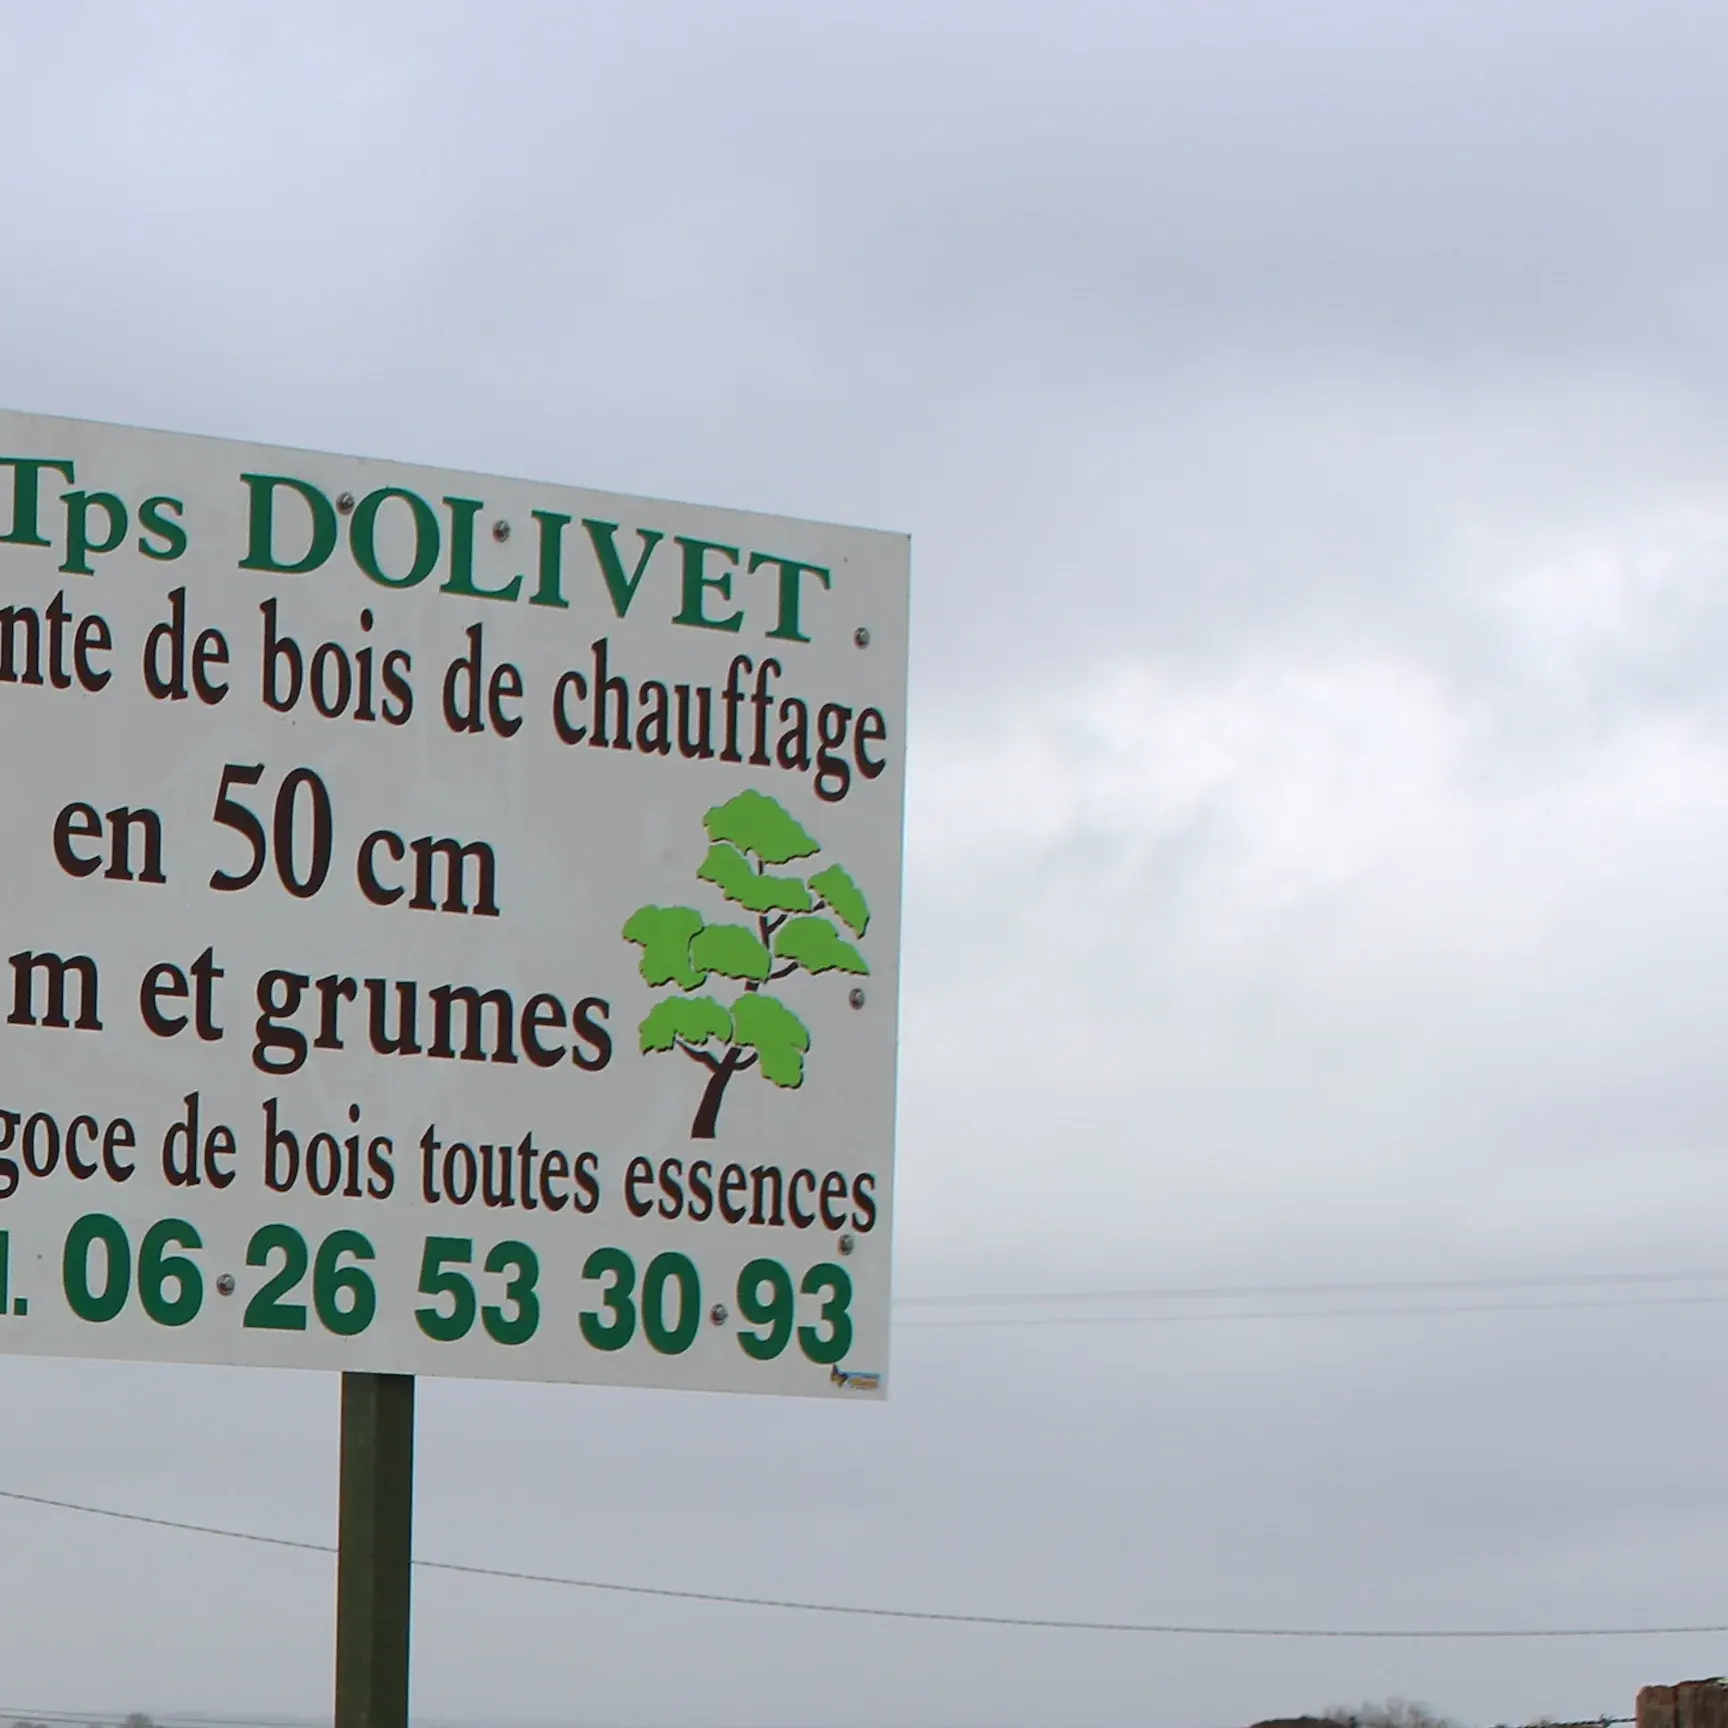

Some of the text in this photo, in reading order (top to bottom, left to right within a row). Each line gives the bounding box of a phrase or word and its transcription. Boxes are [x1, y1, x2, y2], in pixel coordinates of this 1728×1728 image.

[238, 472, 832, 644] DOLIVET
[143, 585, 230, 705] de
[259, 596, 414, 726] bois
[442, 621, 524, 738] de
[553, 636, 887, 803] chauffage
[53, 762, 501, 917] en 50 cm
[6, 950, 104, 1031] m
[140, 946, 225, 1041] et
[252, 969, 613, 1075] grumes
[162, 1090, 237, 1189] de
[262, 1096, 395, 1200] bois
[419, 1123, 601, 1214] toutes
[625, 1155, 877, 1233] essences
[62, 1212, 204, 1327] 06
[243, 1223, 377, 1336] 26
[414, 1235, 541, 1346] 53
[578, 1246, 702, 1356] 30
[736, 1257, 854, 1365] 93
